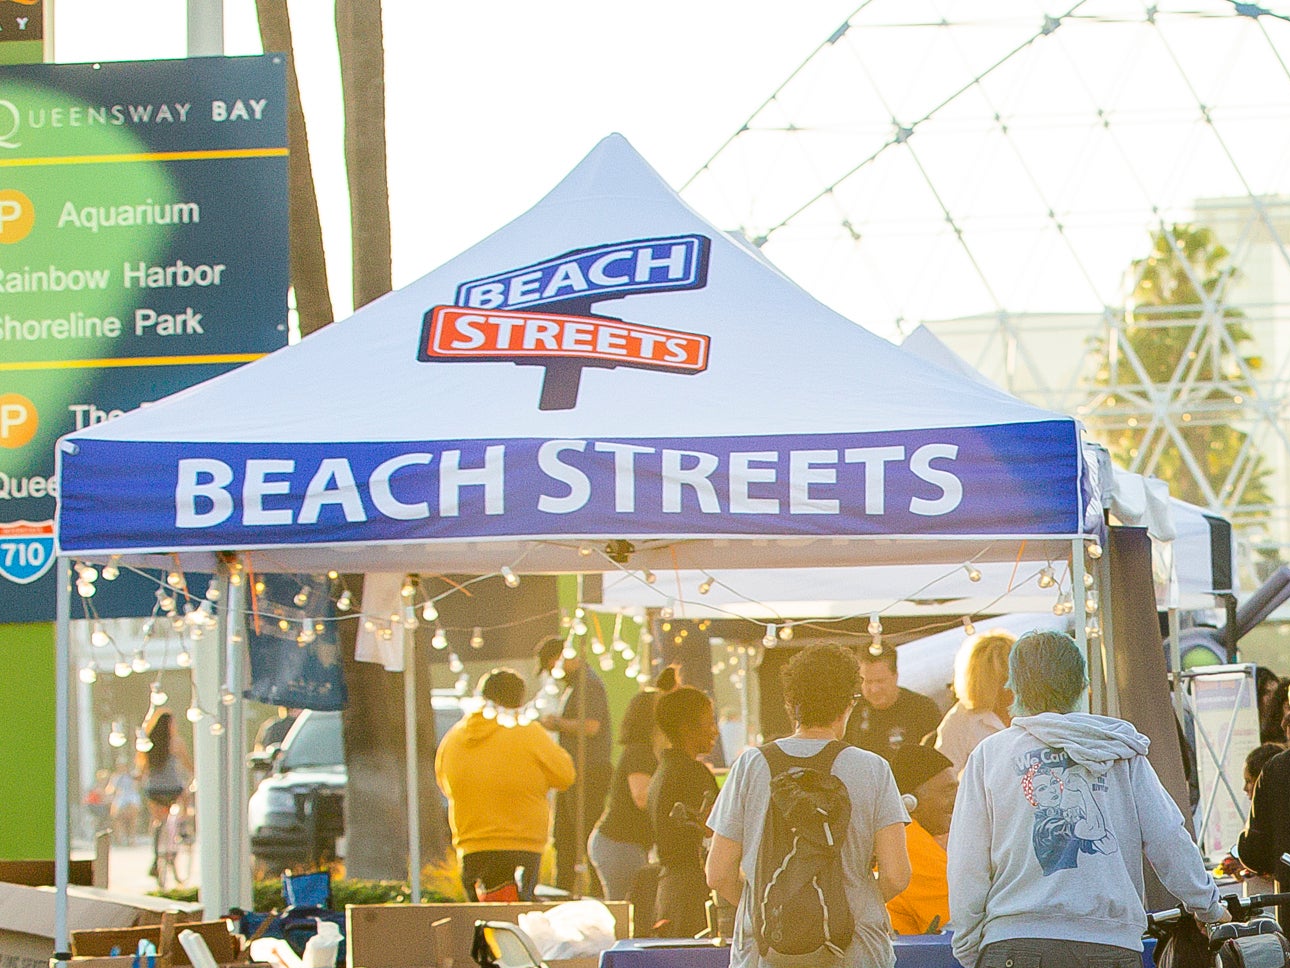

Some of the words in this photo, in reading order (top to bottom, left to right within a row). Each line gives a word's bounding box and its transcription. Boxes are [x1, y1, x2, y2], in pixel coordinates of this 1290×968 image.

[211, 98, 268, 123] BAY
[57, 198, 200, 233] Aquarium
[123, 260, 227, 288] Harbor
[467, 244, 687, 309] BEACH
[0, 312, 121, 341] horeline
[135, 307, 204, 337] Park
[451, 314, 689, 363] STREETS
[0, 404, 28, 438] P
[174, 444, 507, 529] BEACH
[536, 439, 964, 517] STREETS
[1, 541, 46, 567] 710
